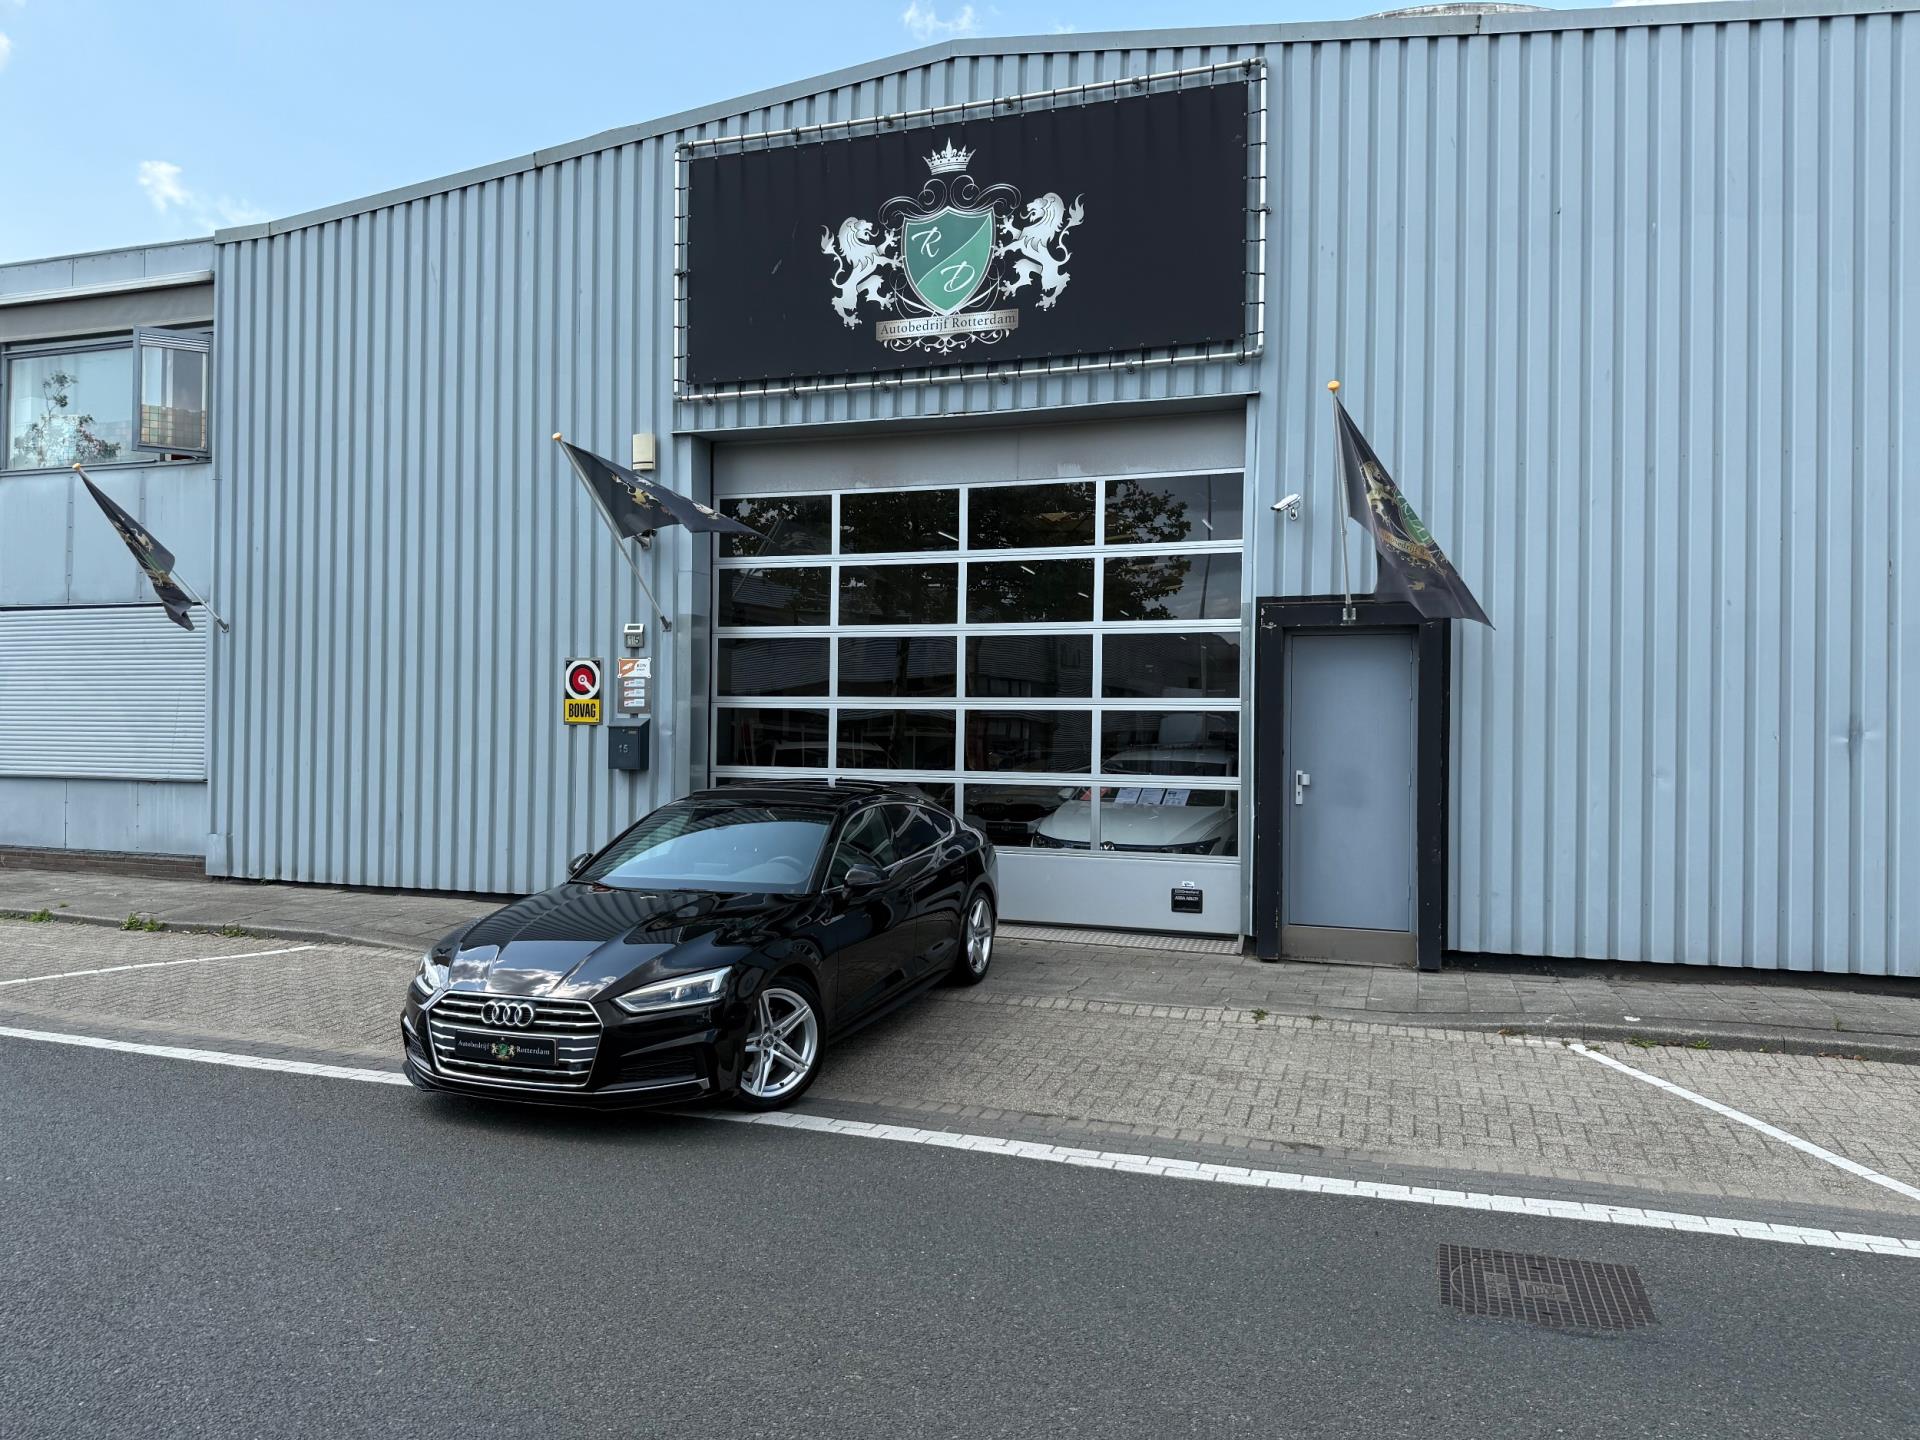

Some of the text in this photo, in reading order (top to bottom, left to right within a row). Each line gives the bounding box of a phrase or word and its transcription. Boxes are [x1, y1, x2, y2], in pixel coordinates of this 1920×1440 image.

[911, 226, 942, 258] R
[881, 313, 1015, 335] Autobedrijf Rotterdam
[568, 703, 596, 718] BOVAG
[457, 1040, 550, 1055] Autobedrijf Rotterdam
